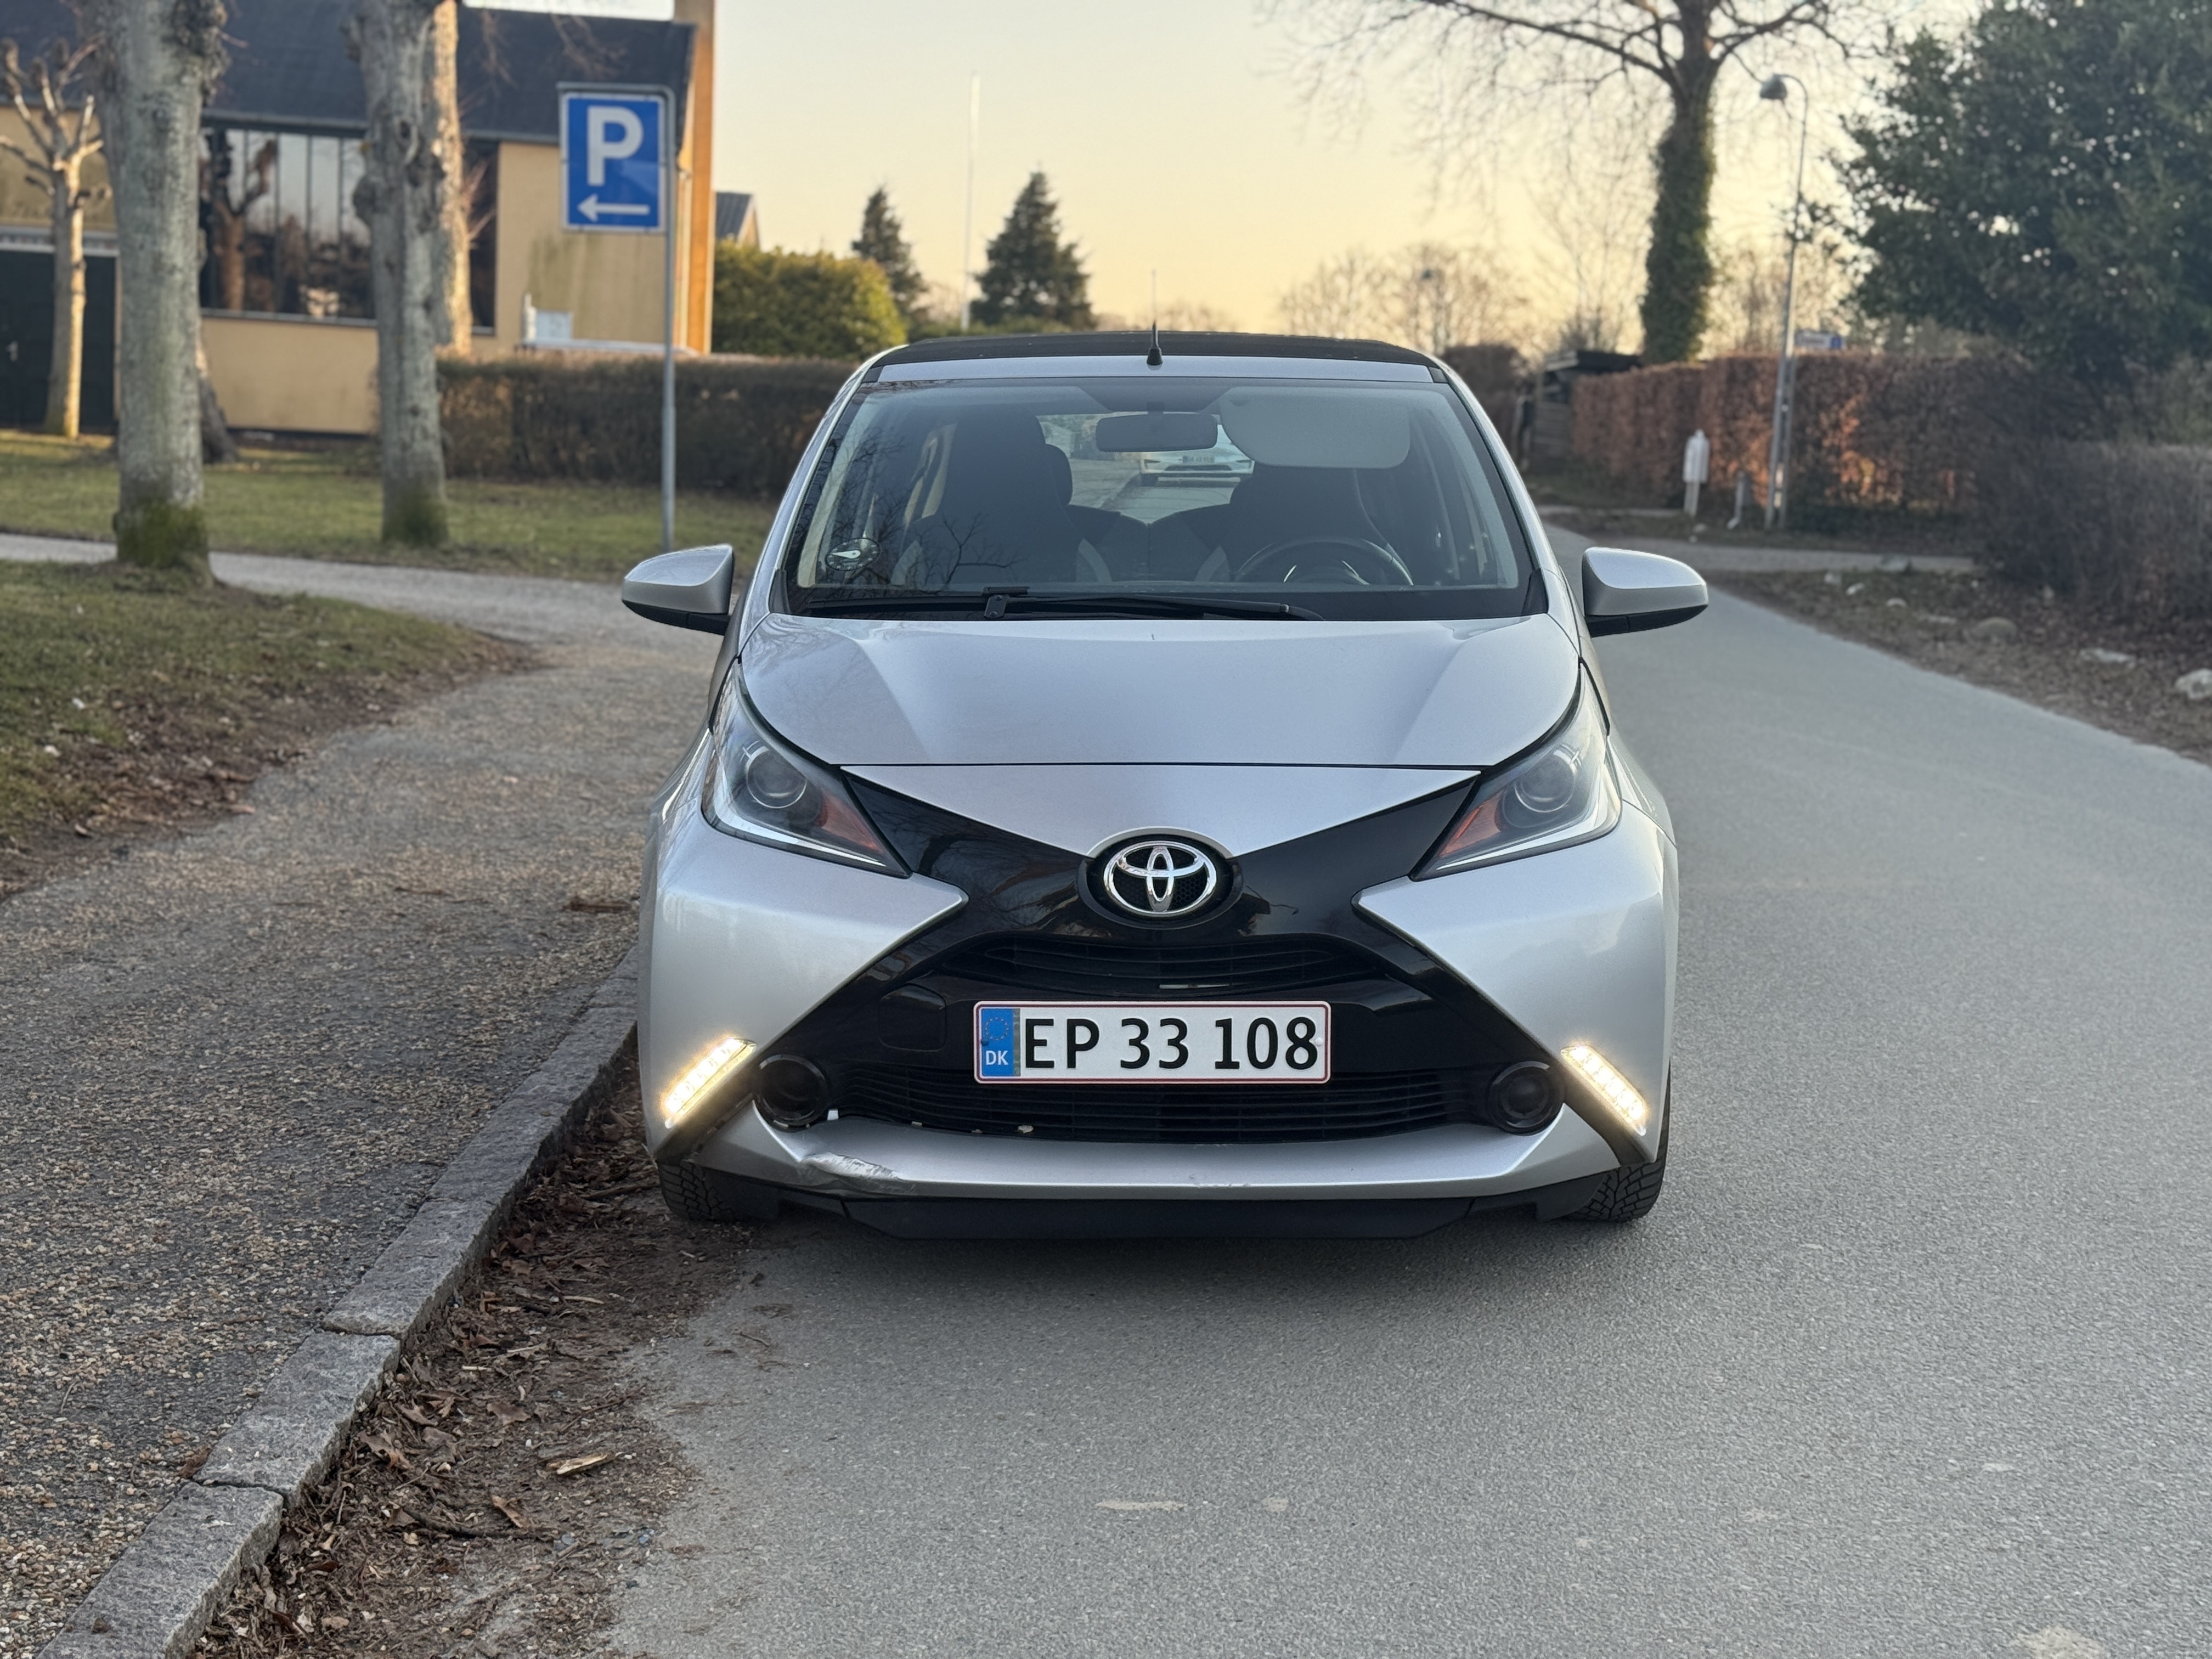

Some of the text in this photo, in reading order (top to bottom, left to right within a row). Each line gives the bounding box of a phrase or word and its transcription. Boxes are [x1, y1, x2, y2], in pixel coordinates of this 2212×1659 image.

[588, 106, 644, 186] P
[985, 1049, 1009, 1065] DK
[1025, 1017, 1318, 1070] EP 33 108
